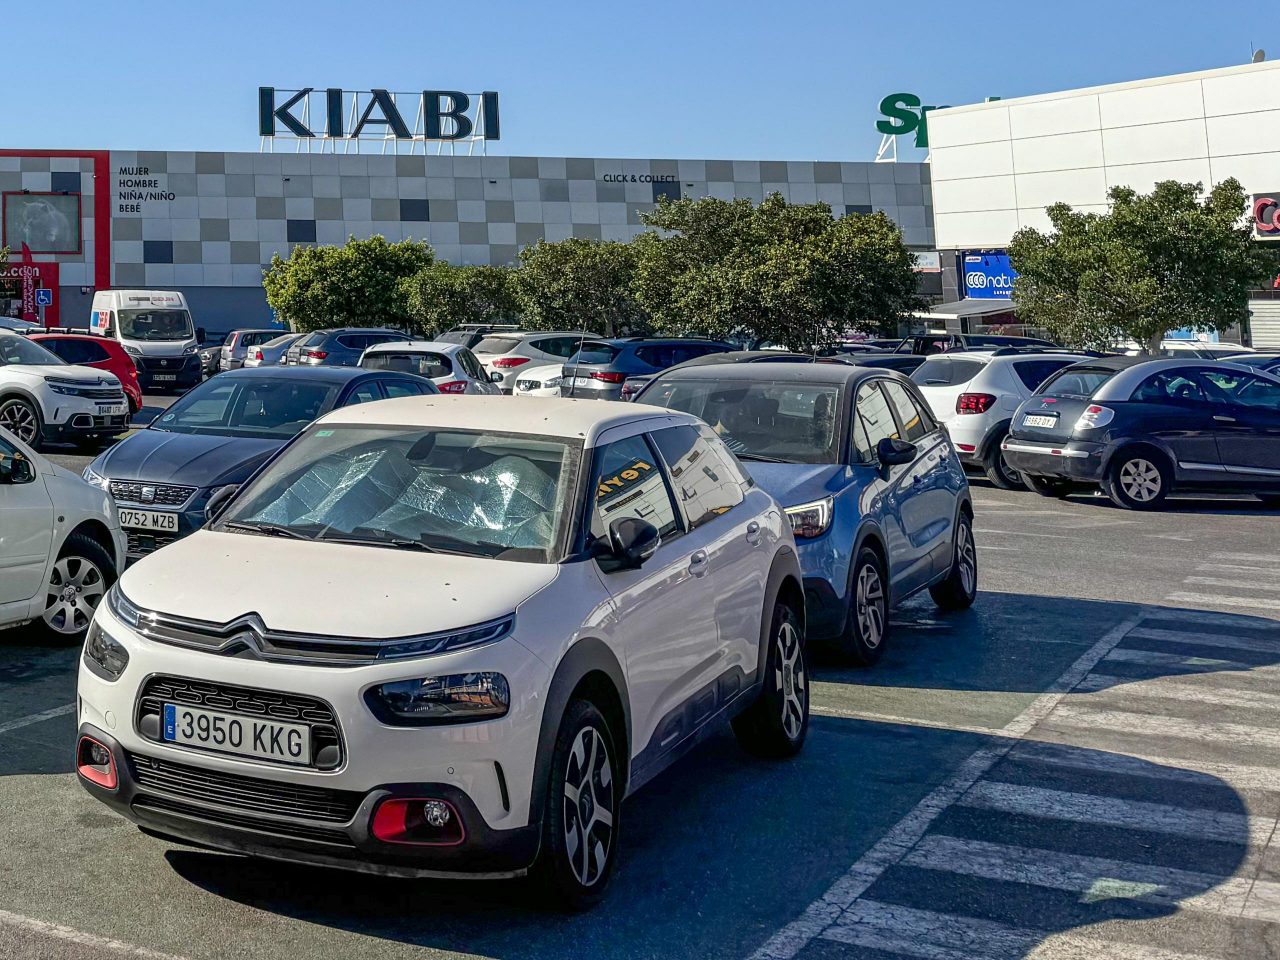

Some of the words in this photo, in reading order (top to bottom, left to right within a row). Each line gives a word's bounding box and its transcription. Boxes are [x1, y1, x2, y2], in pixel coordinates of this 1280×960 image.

[258, 86, 500, 140] KIABI
[119, 166, 149, 176] MUJER
[119, 179, 159, 188] HOMBRE
[603, 174, 628, 183] CLICK
[630, 174, 637, 183] &
[639, 174, 676, 183] COLLECT
[119, 190, 176, 202] NIÑA/NIÑO
[119, 202, 141, 213] BEBÉ
[120, 511, 147, 527] 0752
[152, 514, 175, 529] MZB
[181, 711, 243, 748] 3950
[253, 722, 302, 758] KKG
